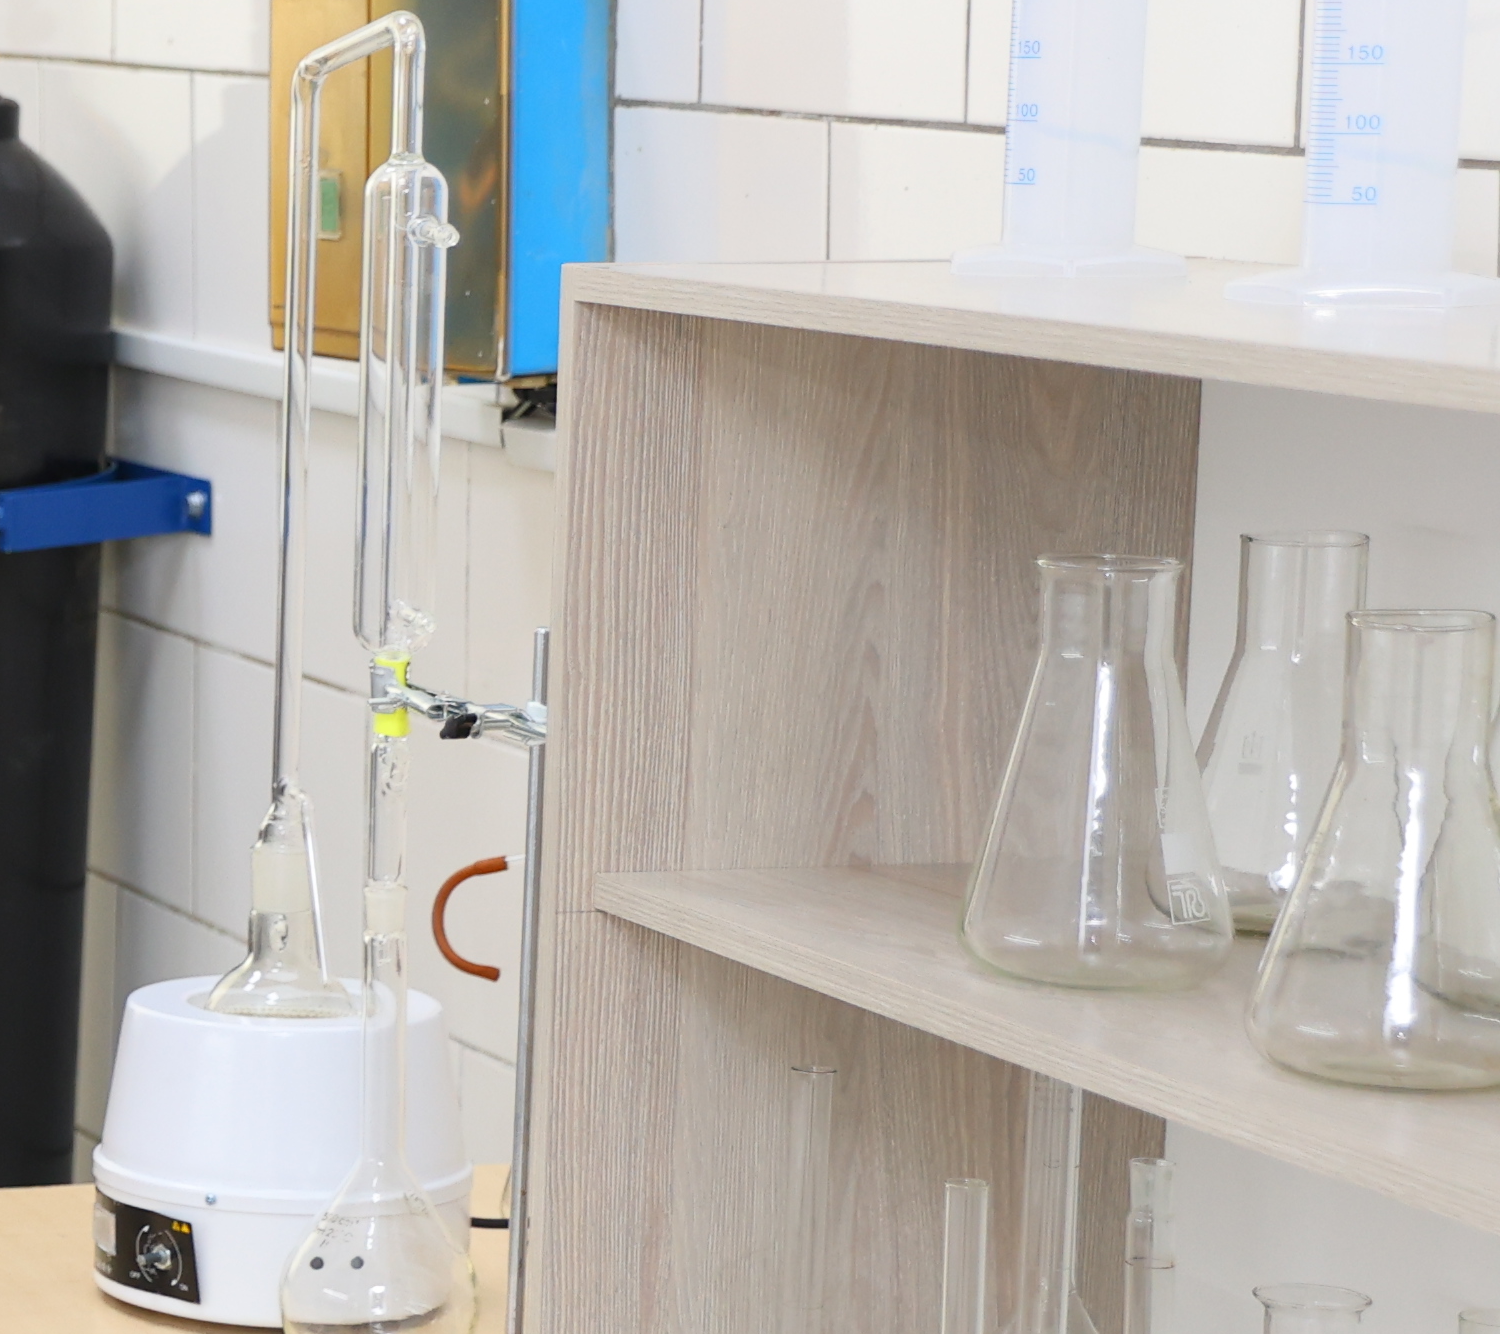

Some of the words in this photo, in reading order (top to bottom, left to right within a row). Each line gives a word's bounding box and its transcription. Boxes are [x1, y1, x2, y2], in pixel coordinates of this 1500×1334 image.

[1018, 41, 1041, 54] 150
[1348, 46, 1383, 60] 150
[1015, 104, 1038, 117] 100
[1345, 115, 1381, 130] 100
[1018, 168, 1035, 182] 50
[1351, 187, 1377, 201] 50
